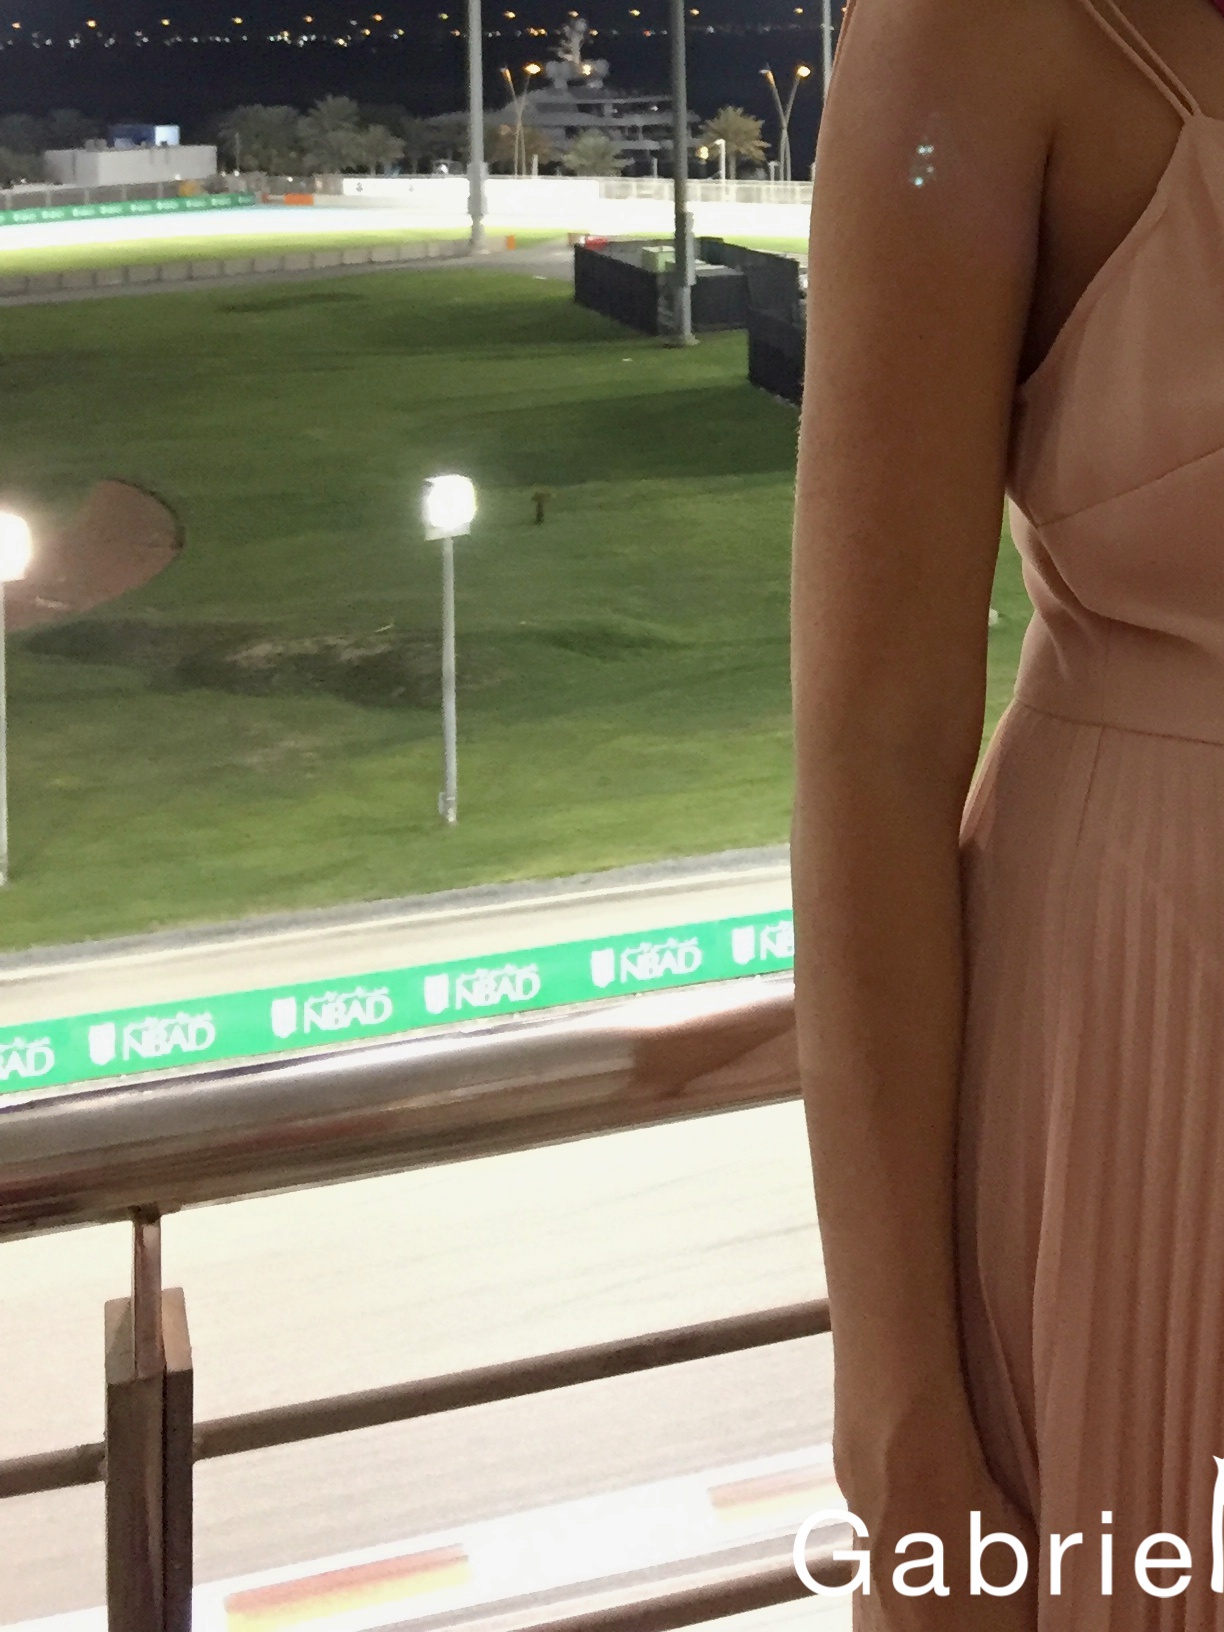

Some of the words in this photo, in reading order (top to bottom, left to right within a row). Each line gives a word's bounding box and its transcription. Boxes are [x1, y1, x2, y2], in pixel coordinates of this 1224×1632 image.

[620, 942, 702, 983] NBAD
[455, 970, 541, 1010] NBAD
[303, 992, 393, 1034] NBAD
[122, 1018, 216, 1061] NBAD
